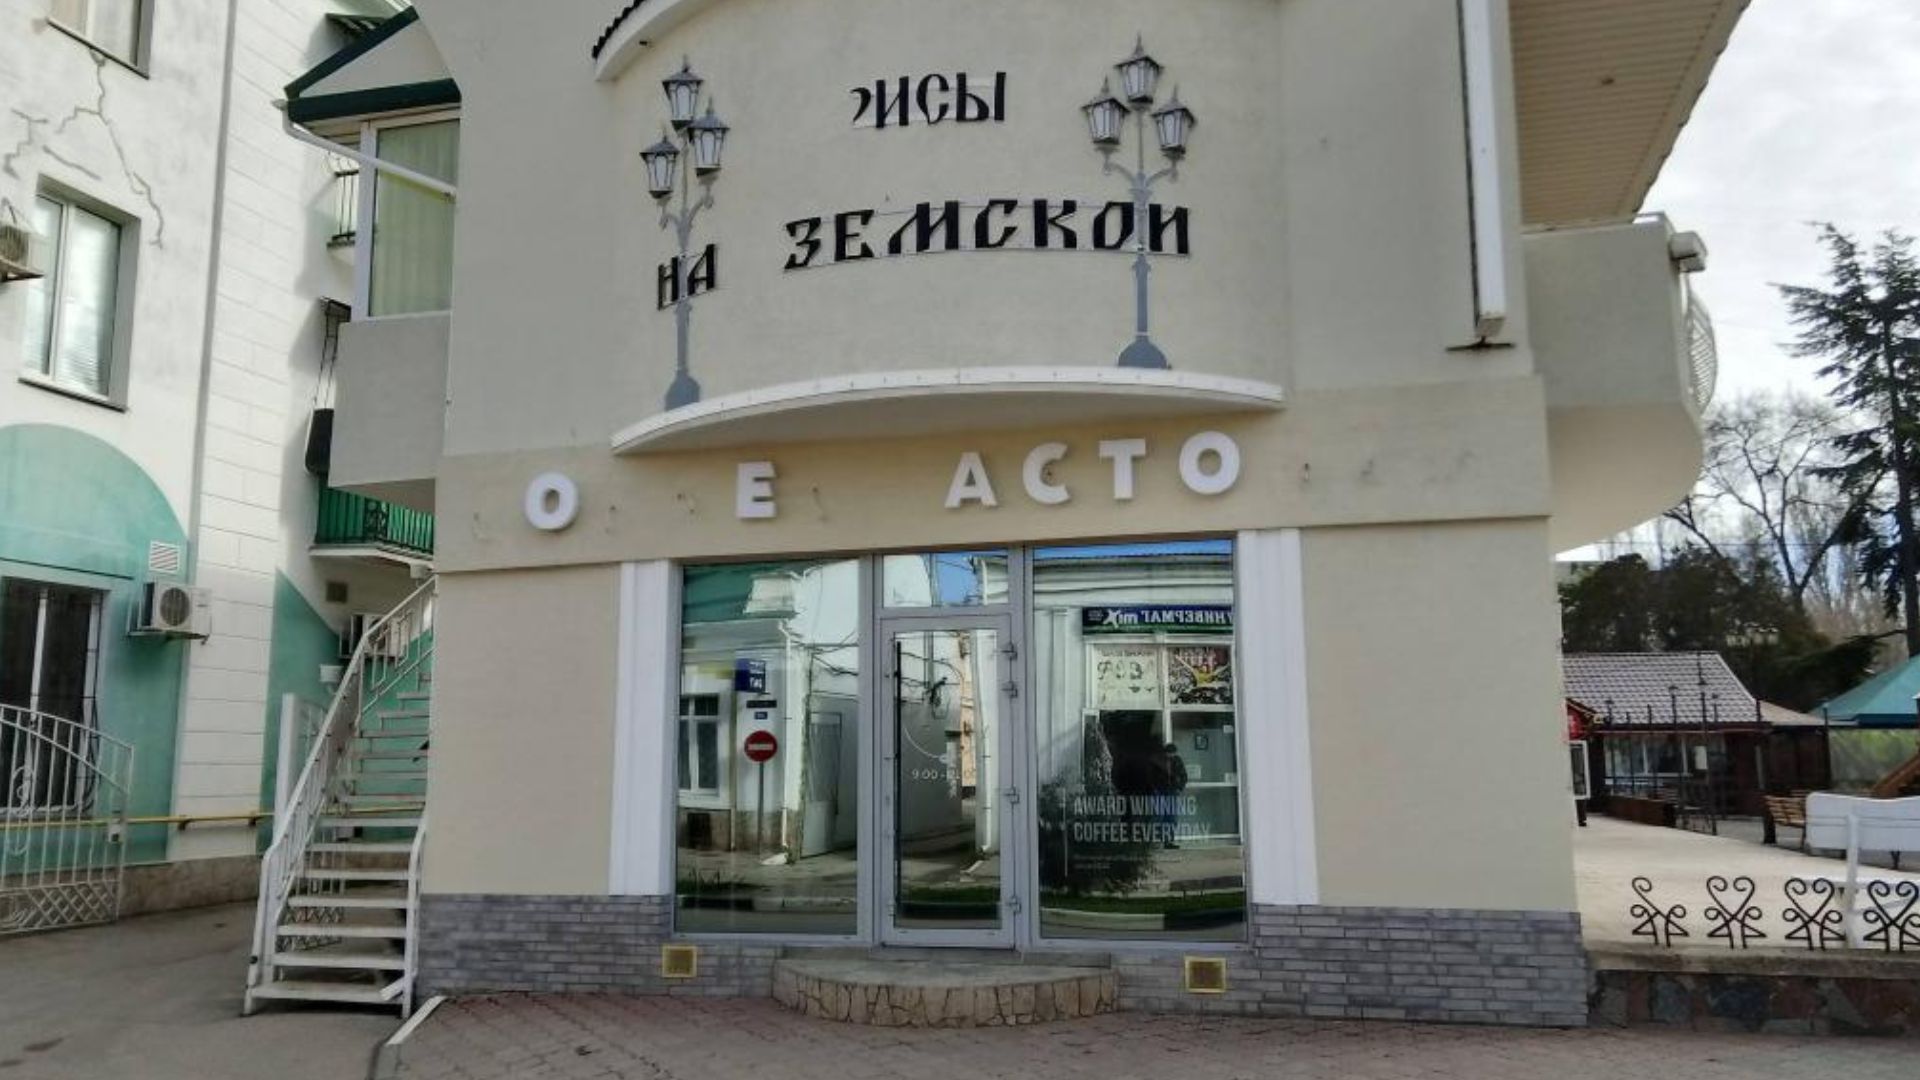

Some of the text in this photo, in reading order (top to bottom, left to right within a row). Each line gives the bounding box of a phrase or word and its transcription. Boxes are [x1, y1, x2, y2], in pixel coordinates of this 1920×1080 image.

[657, 243, 717, 311] НА
[1074, 795, 1196, 816] AWARD WINNING
[1074, 822, 1211, 843] COFFEE EVERYDAY
